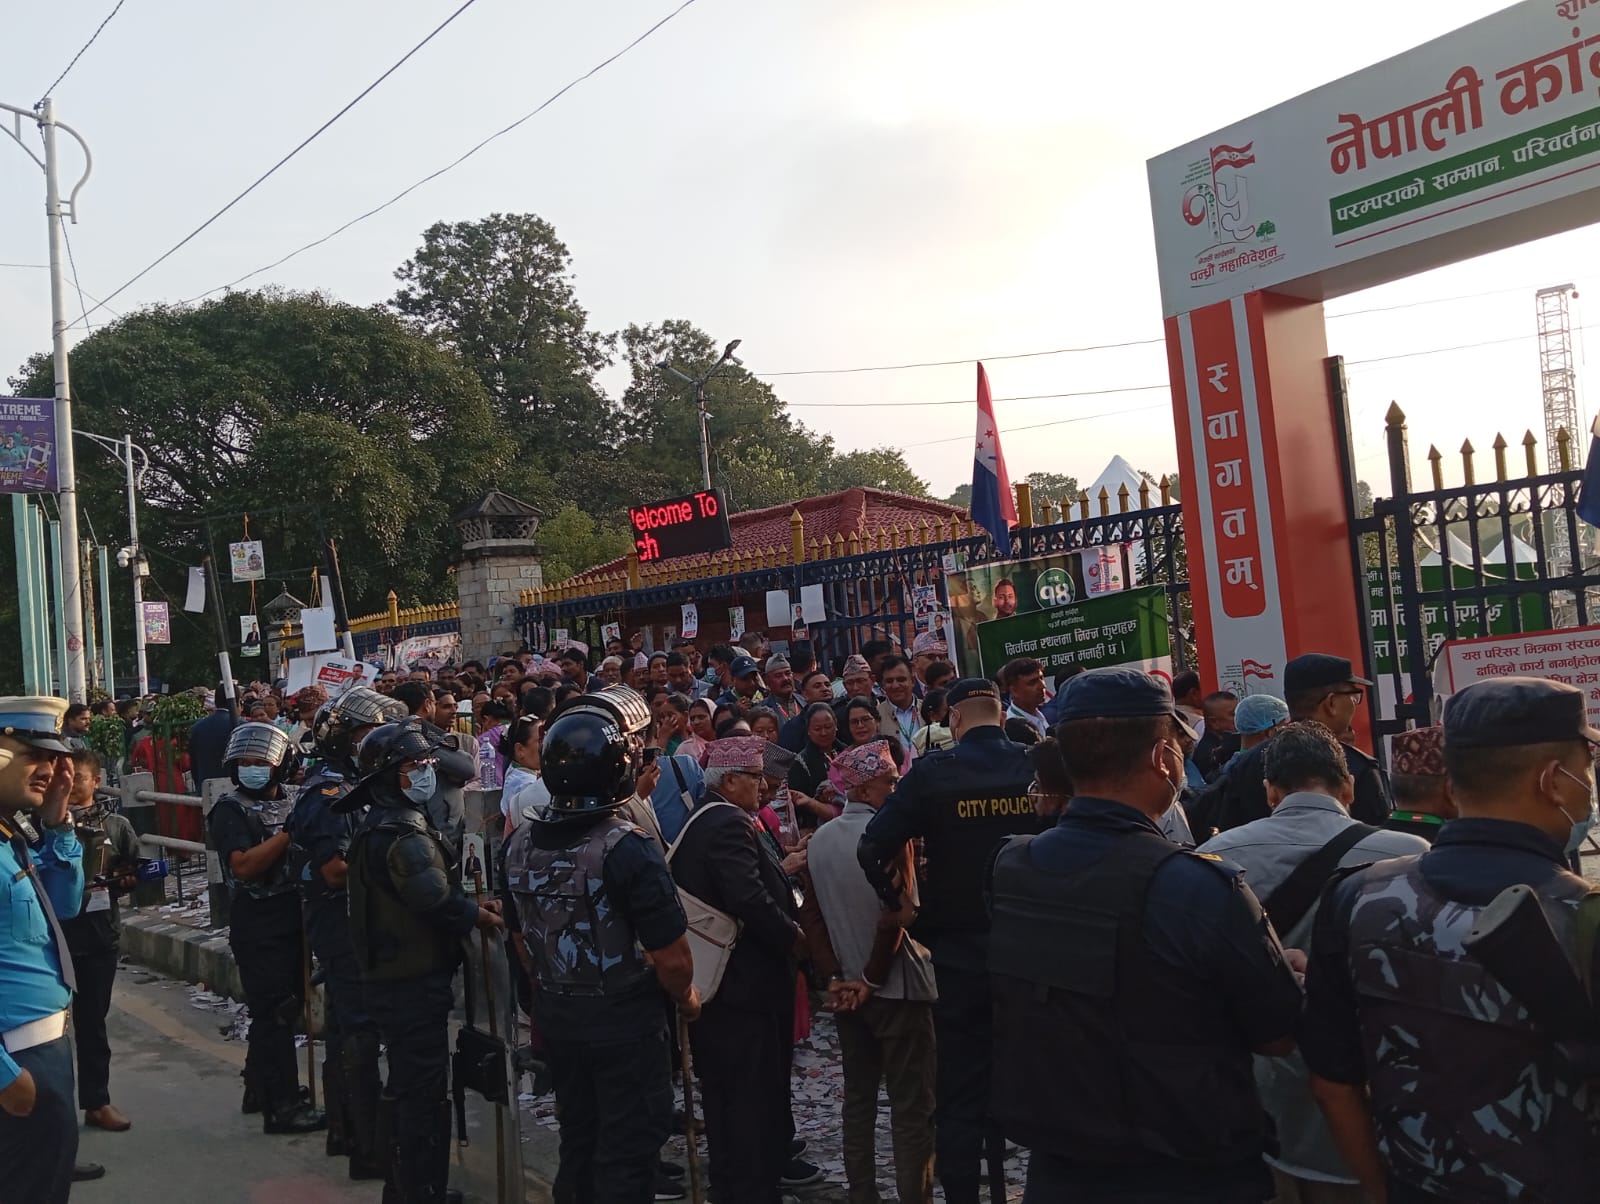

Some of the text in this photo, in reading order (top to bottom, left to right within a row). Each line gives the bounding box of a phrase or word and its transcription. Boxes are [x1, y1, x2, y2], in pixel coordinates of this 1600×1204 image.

[1326, 65, 1484, 175] नेपाली
[1335, 177, 1426, 222] परम्पराको
[1511, 121, 1600, 163] परिवर्तन
[694, 493, 718, 518] To
[1004, 640, 1039, 656] निर्वाचन
[1040, 632, 1072, 649] स्थलमा
[1074, 627, 1099, 642] निम्न
[1462, 650, 1481, 661] यस
[1484, 646, 1520, 660] परिसर
[1524, 642, 1563, 656] भित्रका
[1052, 651, 1075, 666] शख्त
[1077, 642, 1106, 660] मनाही
[1108, 643, 1118, 656] छ
[1519, 658, 1545, 673] कार्य
[1576, 672, 1598, 685] क्षेत्र
[958, 800, 989, 818] CITY
